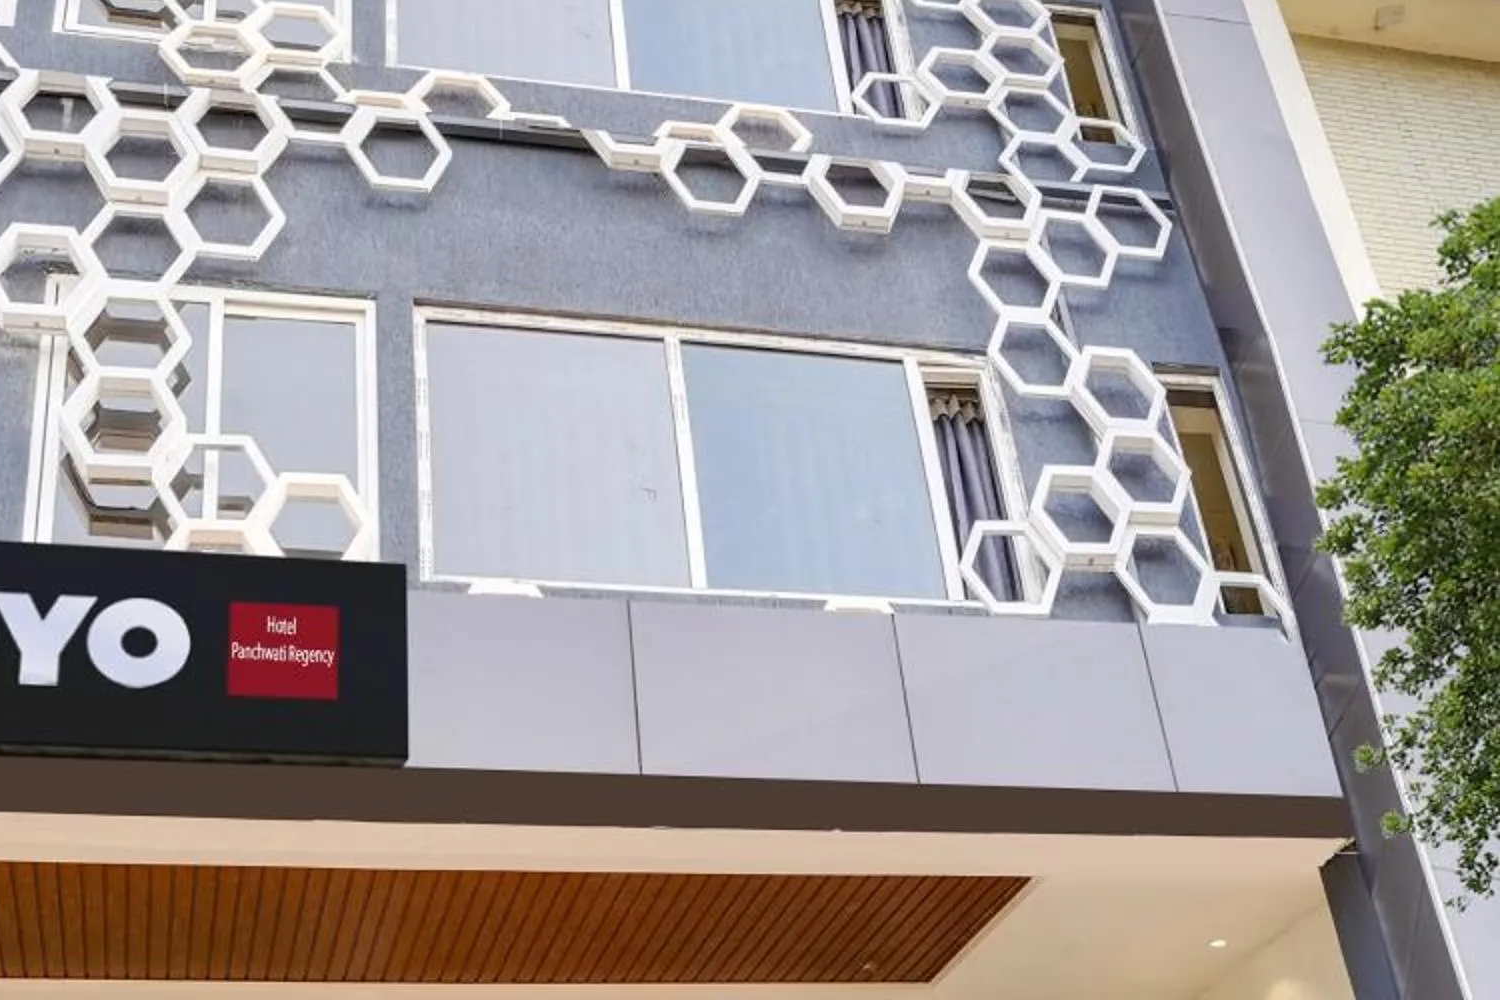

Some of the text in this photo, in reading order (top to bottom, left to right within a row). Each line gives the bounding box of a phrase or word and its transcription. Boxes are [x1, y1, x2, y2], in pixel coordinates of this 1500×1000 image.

[266, 615, 298, 636] Hotel
[230, 641, 336, 669] Panchwati Regency
